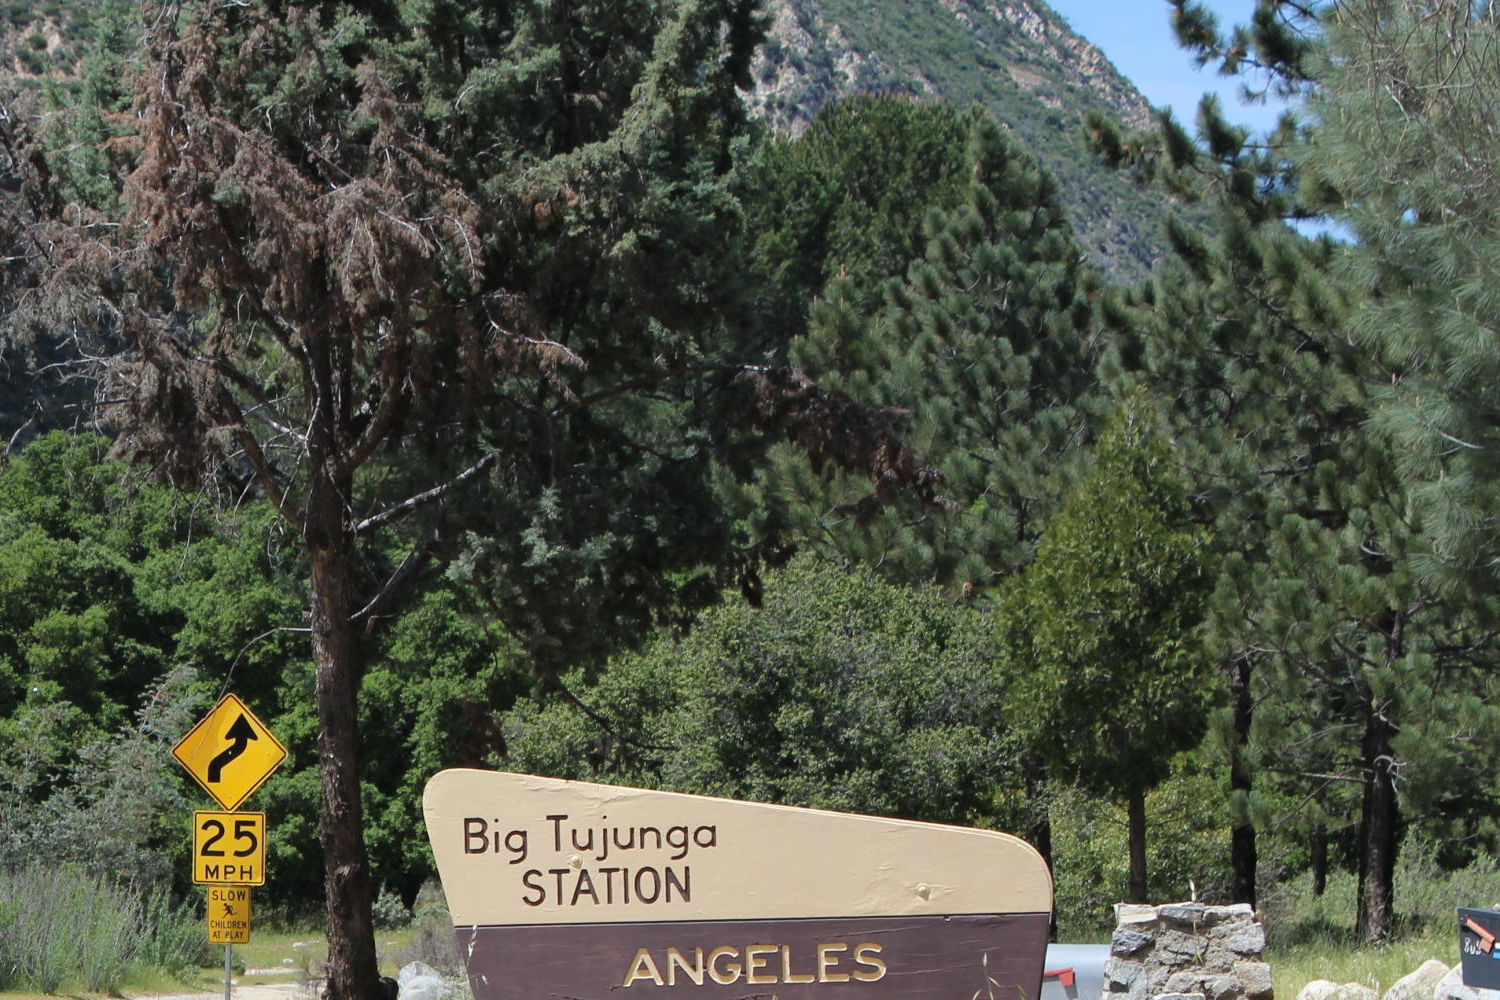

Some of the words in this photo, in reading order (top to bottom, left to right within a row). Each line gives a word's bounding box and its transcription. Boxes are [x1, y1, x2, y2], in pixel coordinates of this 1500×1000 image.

[200, 819, 258, 857] 25
[464, 817, 528, 864] Big
[546, 814, 718, 860] Tujunga
[205, 864, 253, 881] MPH
[521, 865, 692, 907] STATION
[212, 890, 246, 901] SLOW
[210, 920, 247, 929] CHILDREN
[212, 931, 221, 939] AT
[225, 930, 244, 940] PLAY
[622, 942, 888, 988] ANGELES
